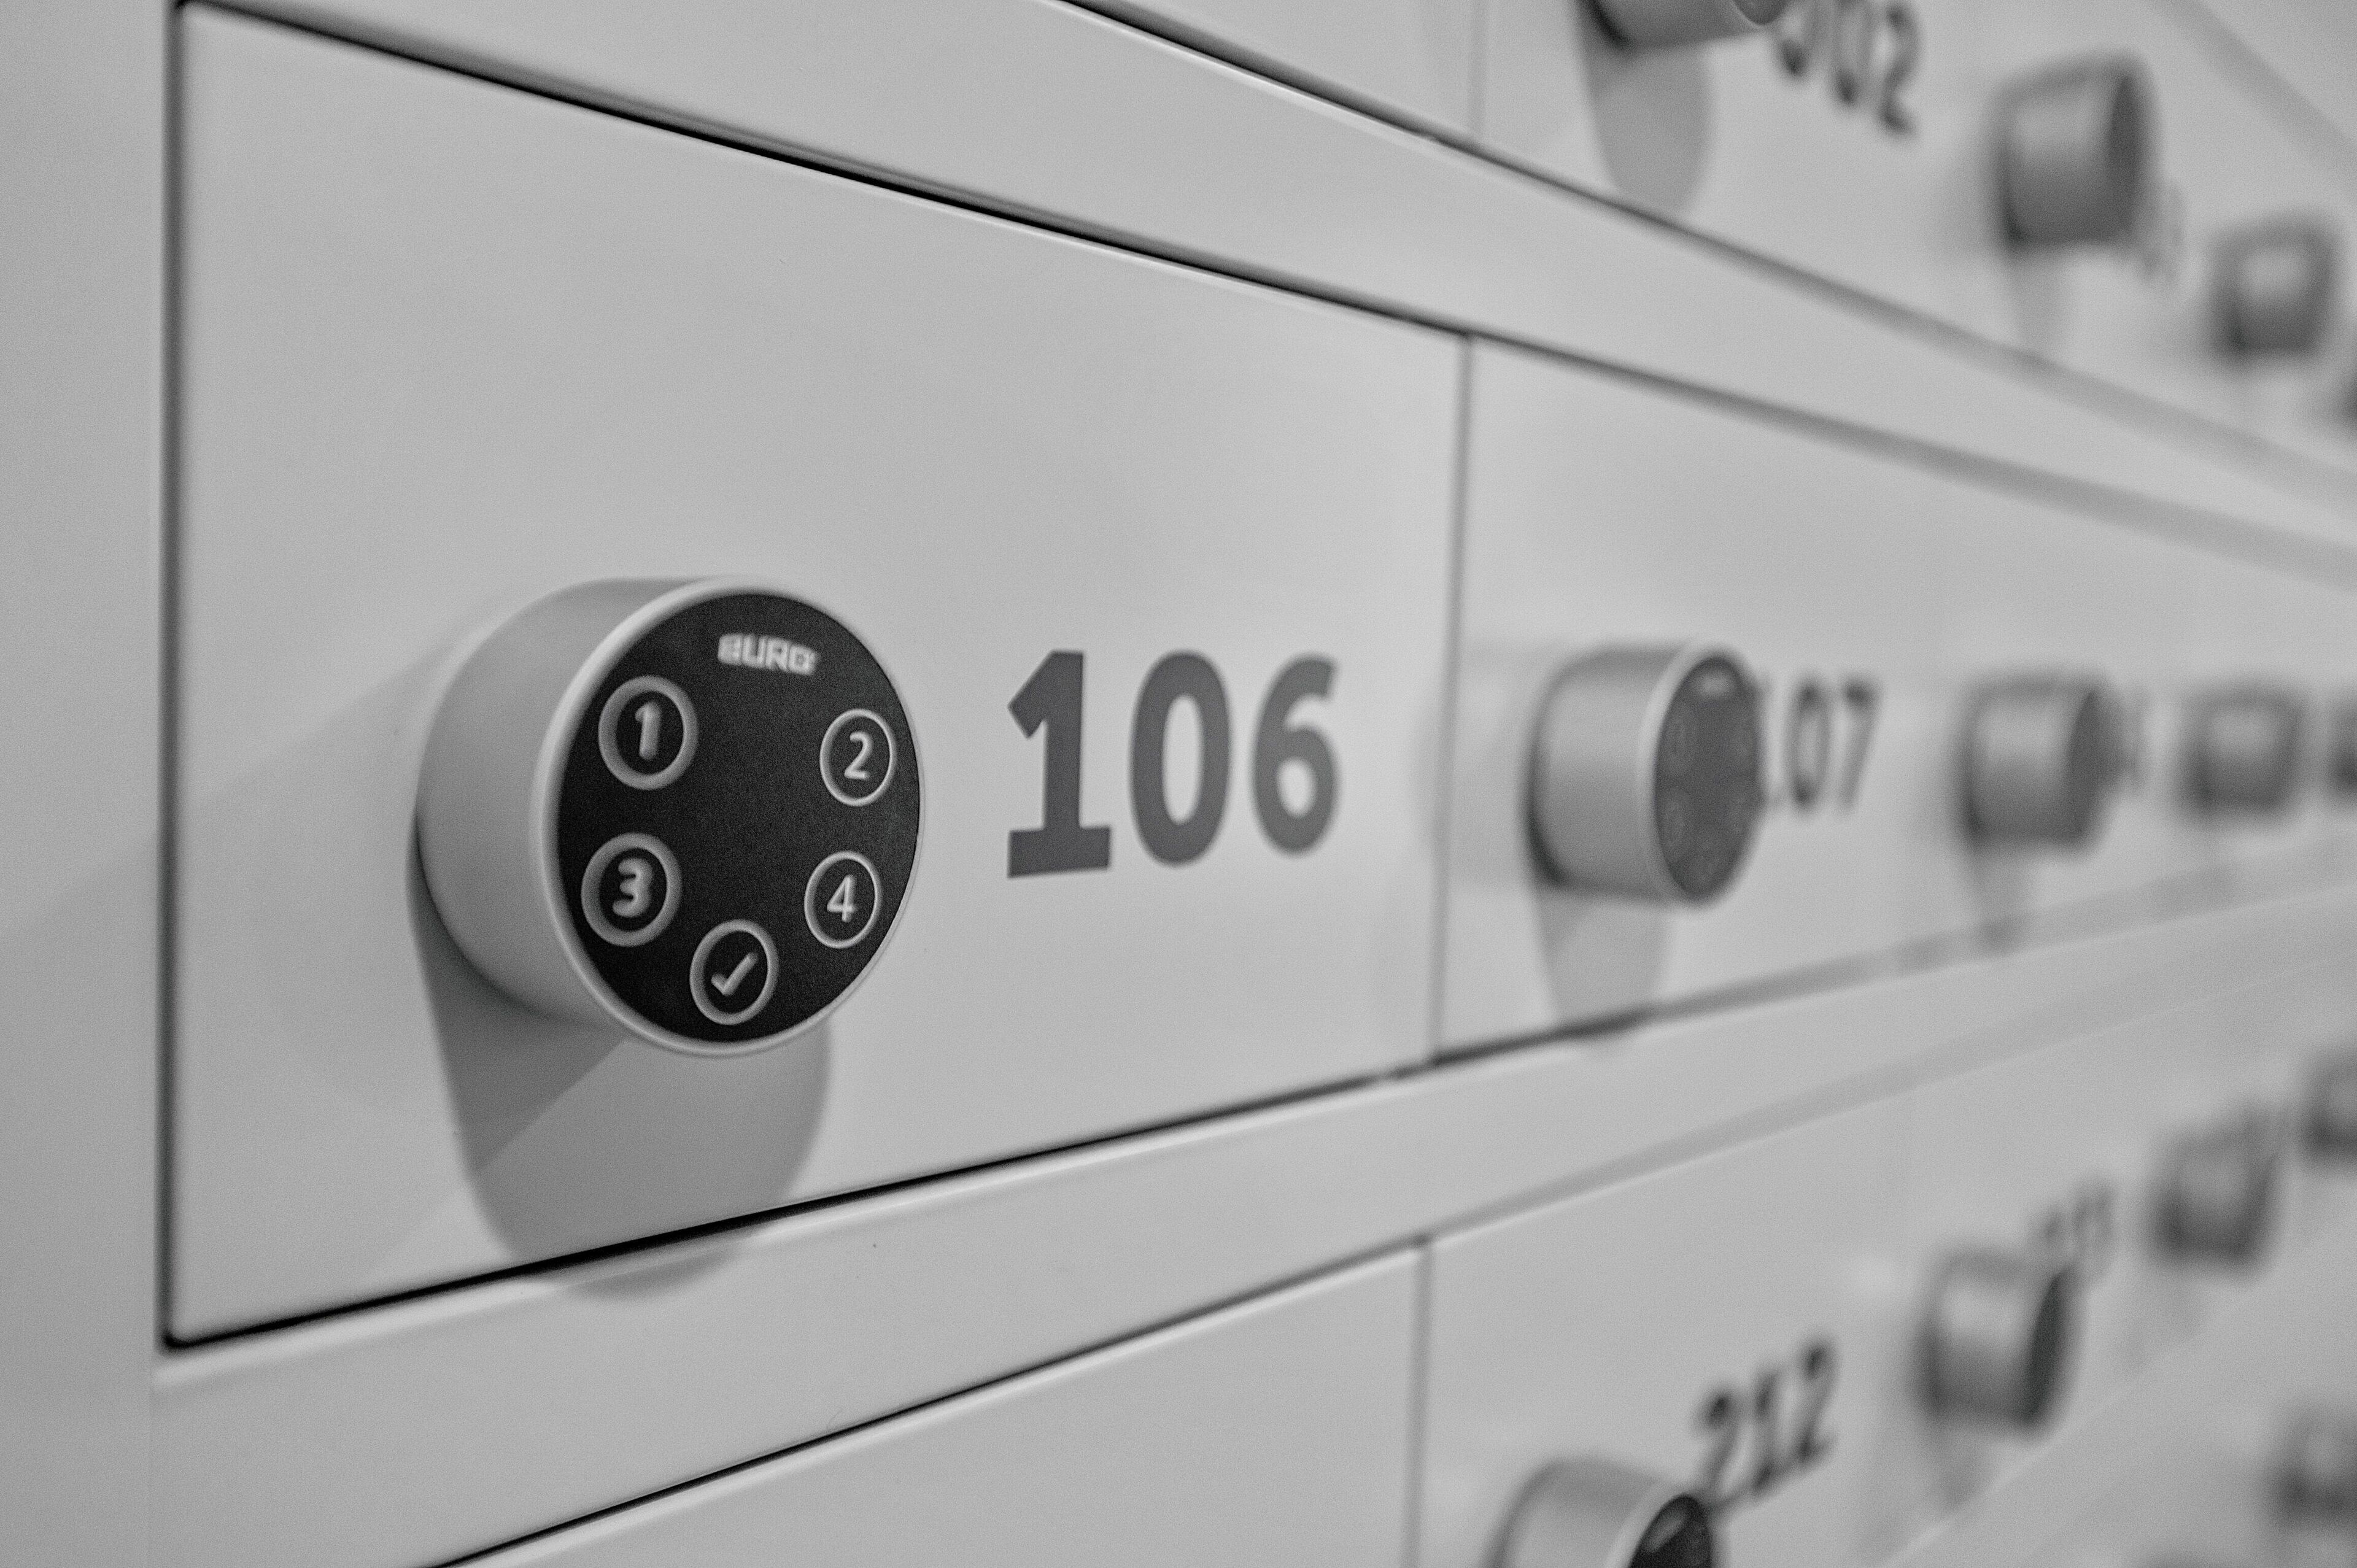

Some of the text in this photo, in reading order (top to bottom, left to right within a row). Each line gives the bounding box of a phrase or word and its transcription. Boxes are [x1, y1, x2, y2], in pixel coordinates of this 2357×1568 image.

[635, 701, 661, 760] 1
[844, 731, 872, 779] 2
[1759, 677, 1882, 816] 07
[1007, 650, 1338, 879] 106
[613, 857, 652, 917] 3
[827, 875, 855, 922] 4
